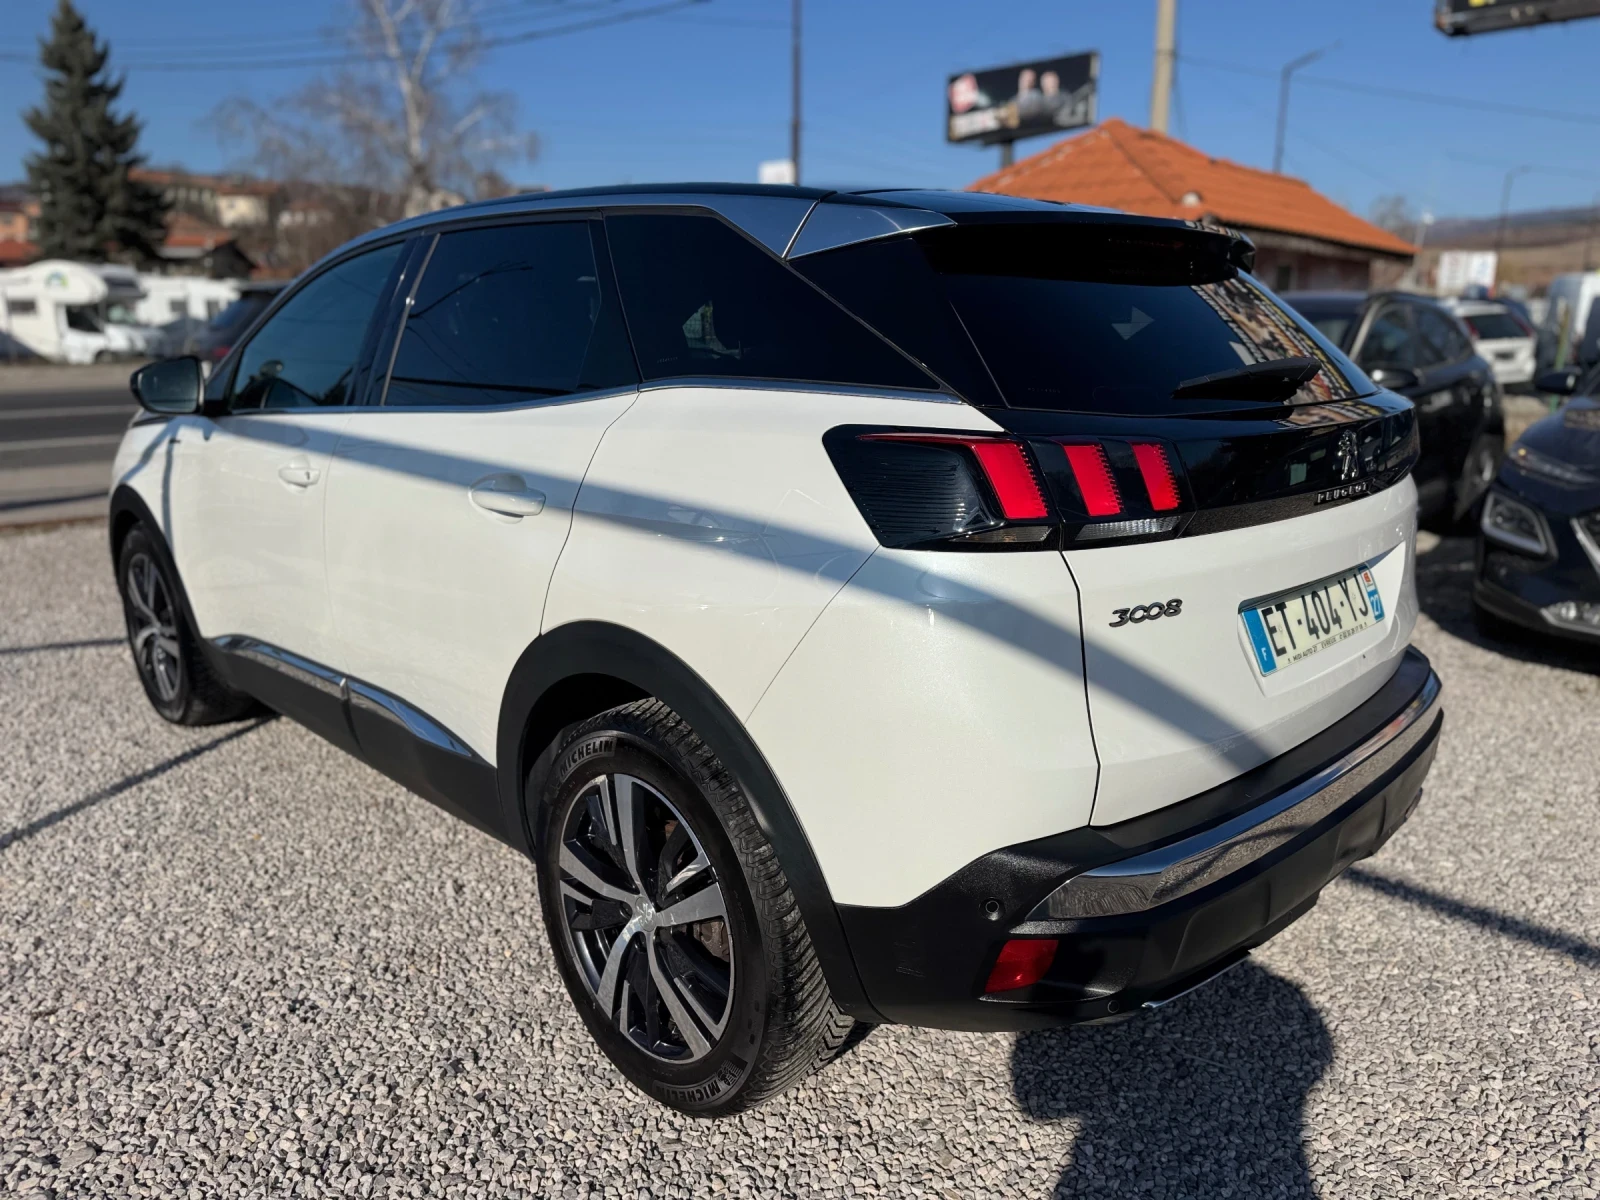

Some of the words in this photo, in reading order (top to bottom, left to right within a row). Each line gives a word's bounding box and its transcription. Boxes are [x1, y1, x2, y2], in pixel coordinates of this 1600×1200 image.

[1317, 481, 1368, 503] PEUGEOT
[1108, 598, 1183, 628] 3008
[1260, 646, 1268, 661] F
[560, 740, 614, 777] MICHELIN
